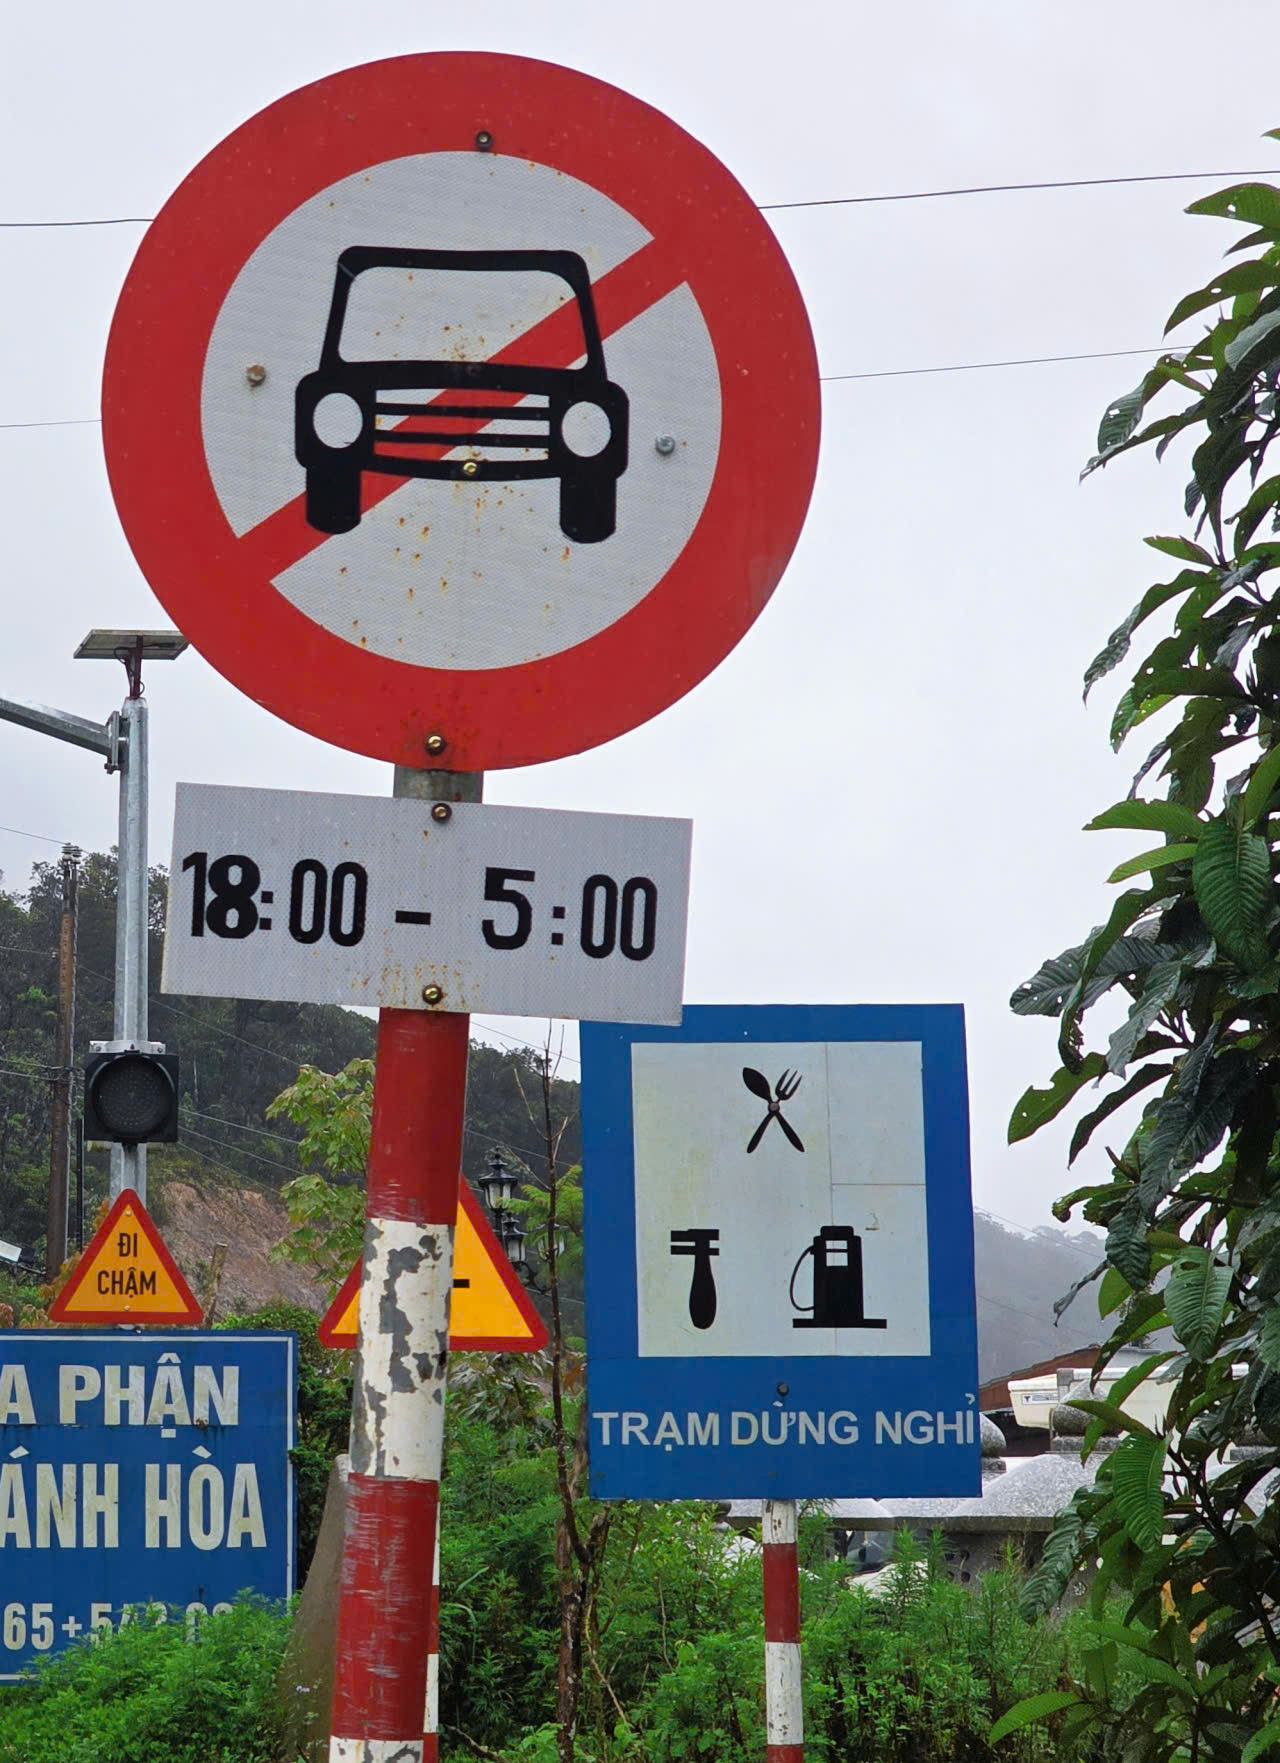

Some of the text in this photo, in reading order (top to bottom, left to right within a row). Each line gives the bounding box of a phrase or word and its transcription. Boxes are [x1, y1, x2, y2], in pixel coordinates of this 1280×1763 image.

[182, 851, 368, 947] 18:00
[482, 866, 658, 961] 5:00
[117, 1232, 138, 1257] ĐI
[97, 1266, 156, 1298] CHẬM
[59, 1352, 239, 1438] PHẬN
[592, 1393, 975, 1451] TRẠM DỪNG NGHỈ
[145, 1445, 267, 1550] HÒA
